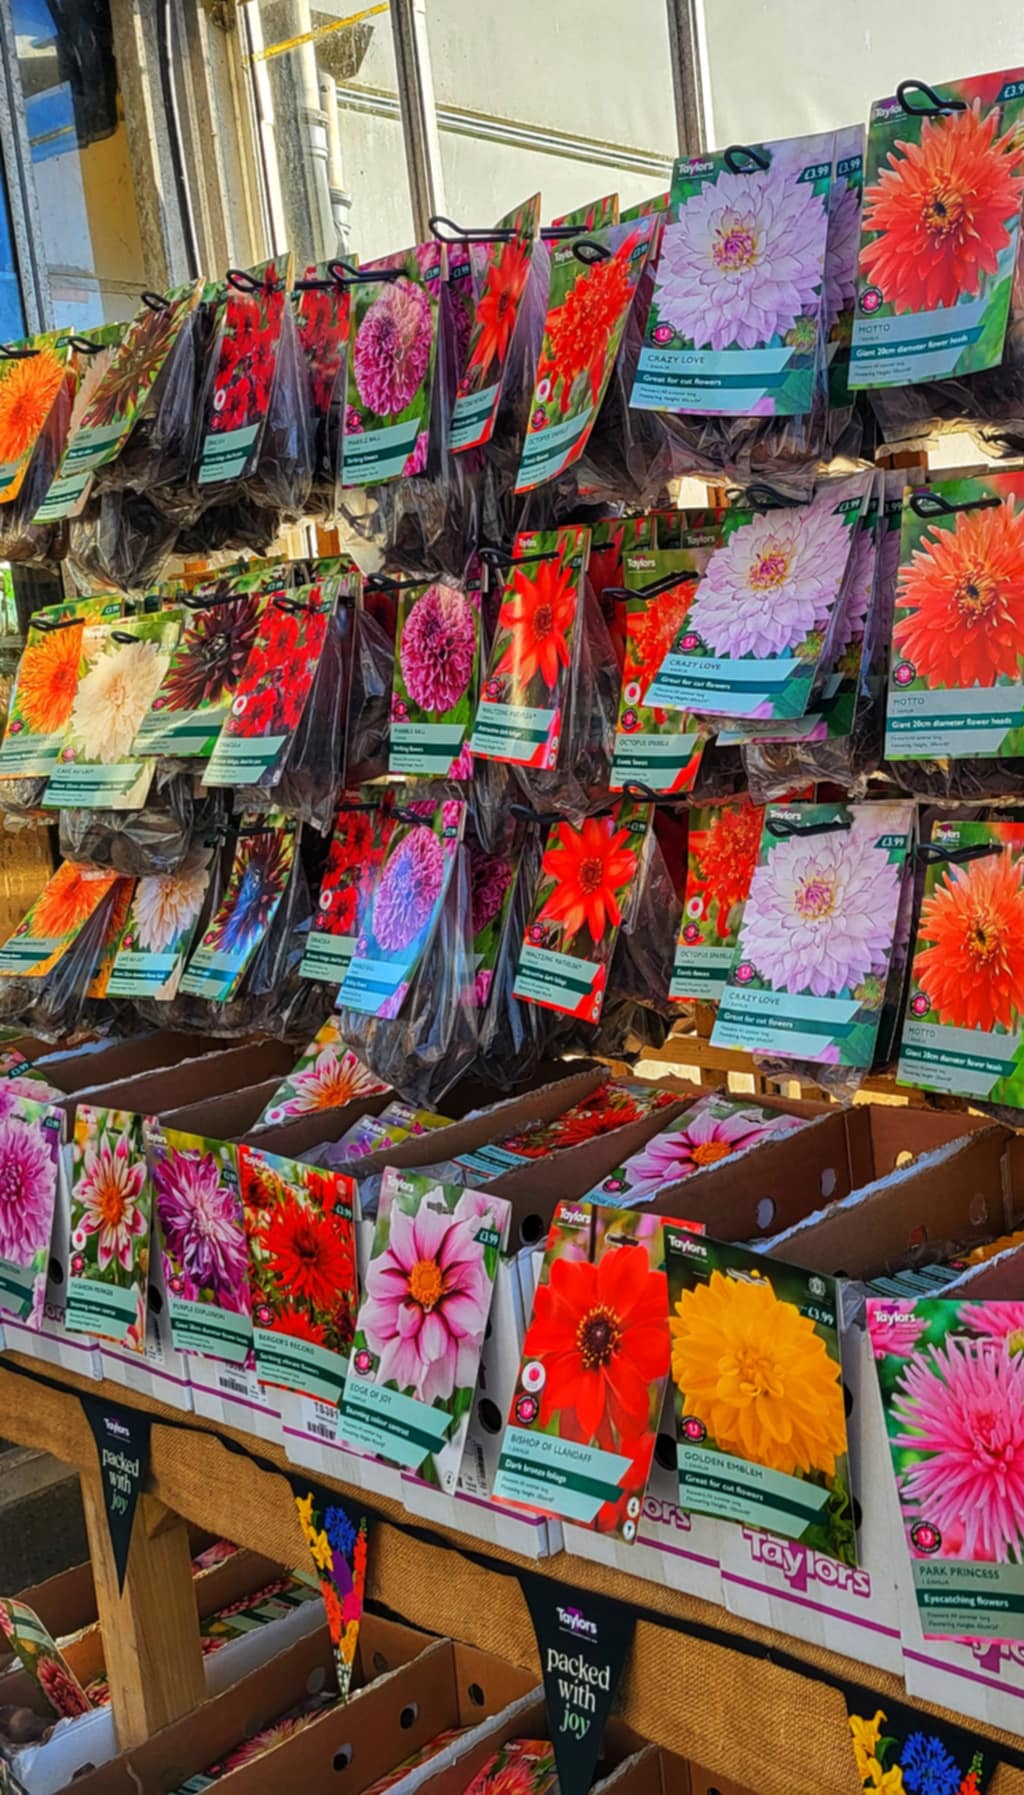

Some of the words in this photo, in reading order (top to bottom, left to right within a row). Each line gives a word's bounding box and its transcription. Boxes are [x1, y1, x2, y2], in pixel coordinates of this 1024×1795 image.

[678, 161, 714, 176] Taylors
[804, 165, 829, 180] £3.99
[859, 325, 890, 333] MOTTO
[627, 558, 655, 570] Taylors
[882, 837, 904, 847] £3.99
[730, 992, 757, 1002] CRAZY
[758, 996, 780, 1005] LOVE
[559, 1207, 590, 1224] Taylors
[479, 1231, 499, 1245] £3.99
[668, 1234, 707, 1256] Taylors
[808, 1307, 833, 1324] £3.99
[874, 1311, 916, 1326] Taylors
[104, 1418, 130, 1437] Taylors
[102, 1448, 139, 1478] packed
[685, 1452, 723, 1468] GOLDEN
[725, 1461, 763, 1479] EMBLEM
[110, 1471, 131, 1493] with
[686, 1473, 707, 1485] Great
[709, 1478, 721, 1489] for
[722, 1481, 734, 1492] cut
[736, 1484, 763, 1501] flowers
[111, 1490, 128, 1514] joy
[744, 1528, 870, 1598] Taylors
[920, 1566, 947, 1577] PARK
[950, 1567, 1000, 1580] PRINCESS
[923, 1593, 974, 1609] Eyecatching
[977, 1596, 1009, 1609] flowers
[556, 1606, 597, 1634] Taylors
[548, 1648, 610, 1691] packed
[558, 1678, 596, 1712] with
[560, 1706, 590, 1740] joy
